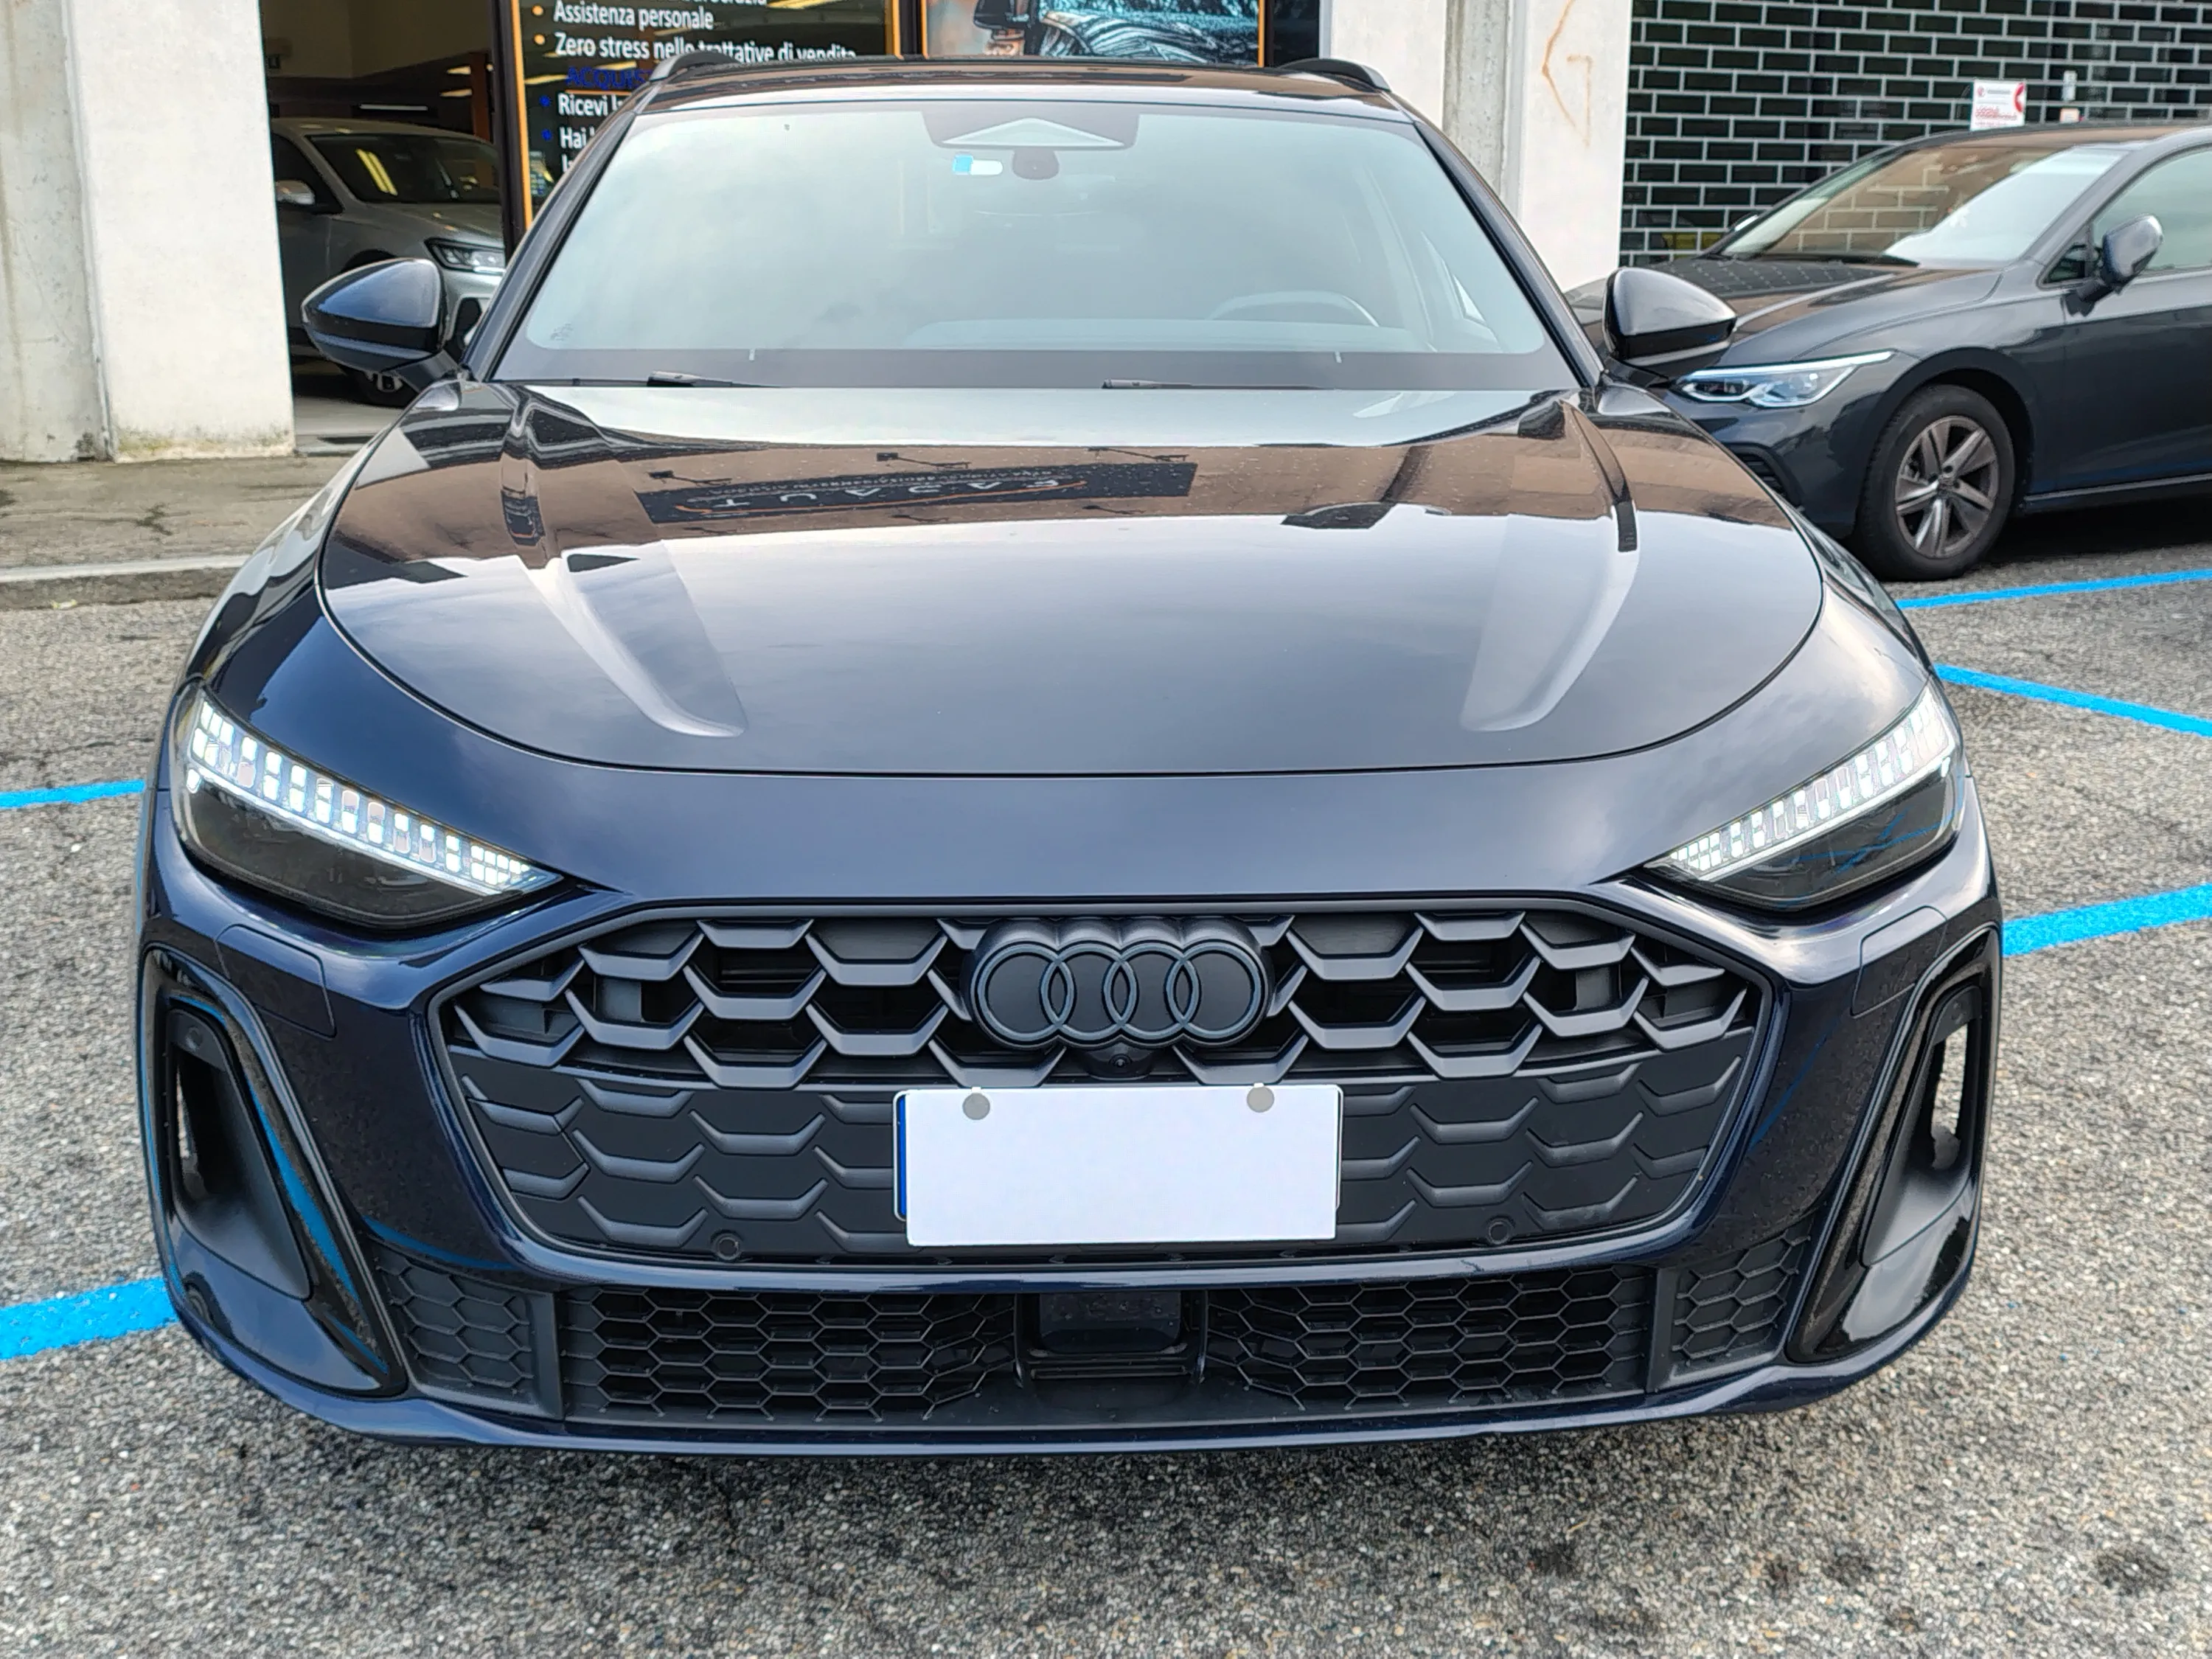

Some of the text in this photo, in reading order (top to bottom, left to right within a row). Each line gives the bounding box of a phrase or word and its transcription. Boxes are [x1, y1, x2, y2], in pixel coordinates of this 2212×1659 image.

[554, 1, 714, 31] Assistenza personale
[554, 32, 596, 57] Zero
[599, 36, 650, 59] stress
[778, 42, 795, 62] di
[558, 94, 608, 116] Ricevi
[560, 126, 587, 149] Hai
